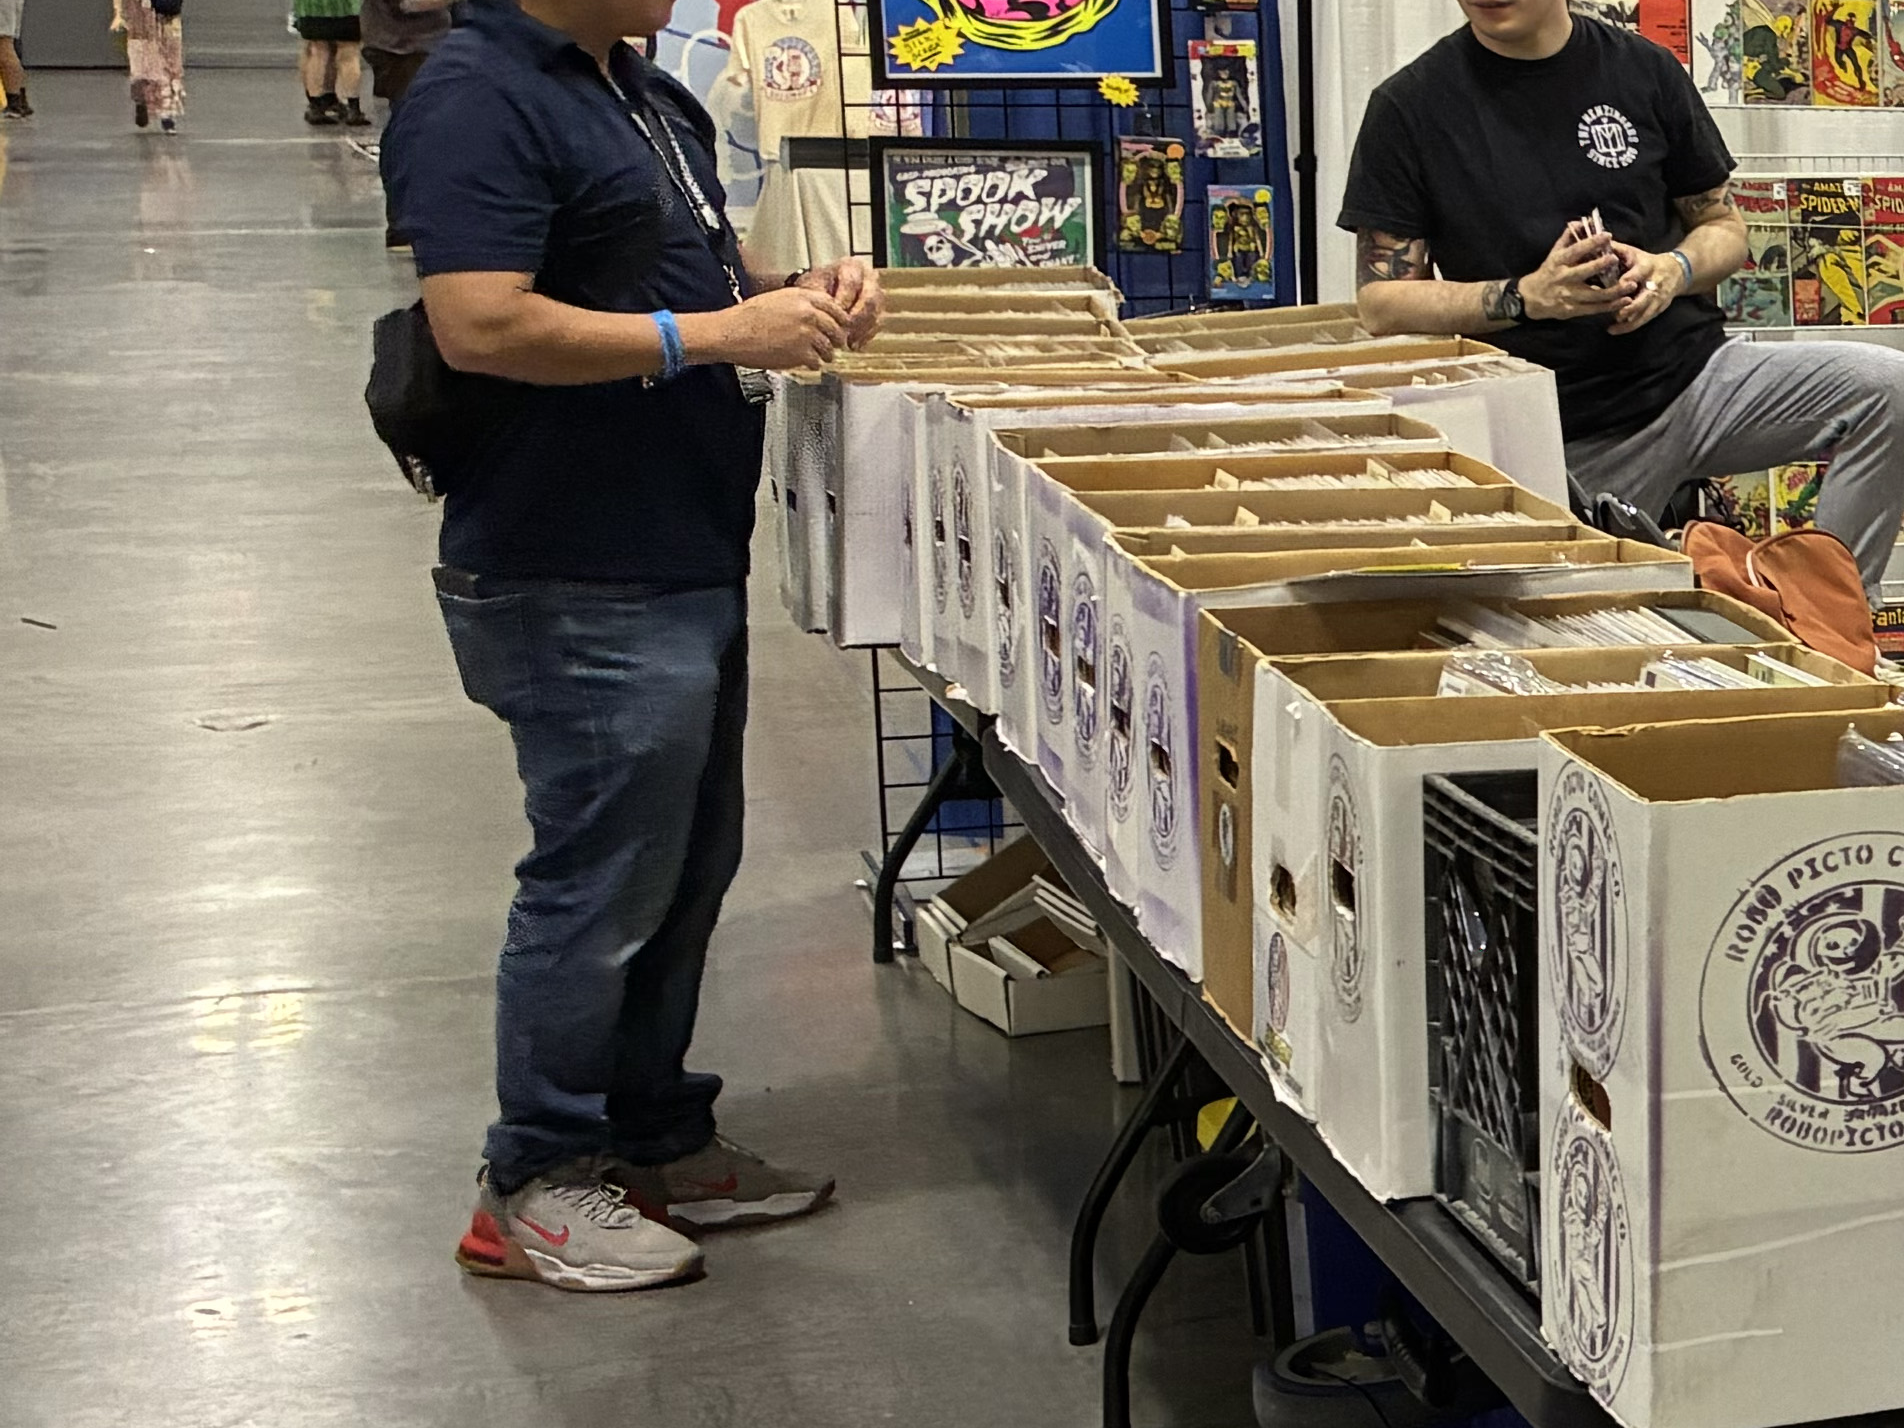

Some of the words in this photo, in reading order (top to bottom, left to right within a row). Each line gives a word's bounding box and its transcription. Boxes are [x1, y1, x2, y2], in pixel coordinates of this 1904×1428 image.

[902, 169, 1048, 213] SPOOK
[958, 194, 1082, 236] SHOW
[1787, 844, 1875, 891] PICTO
